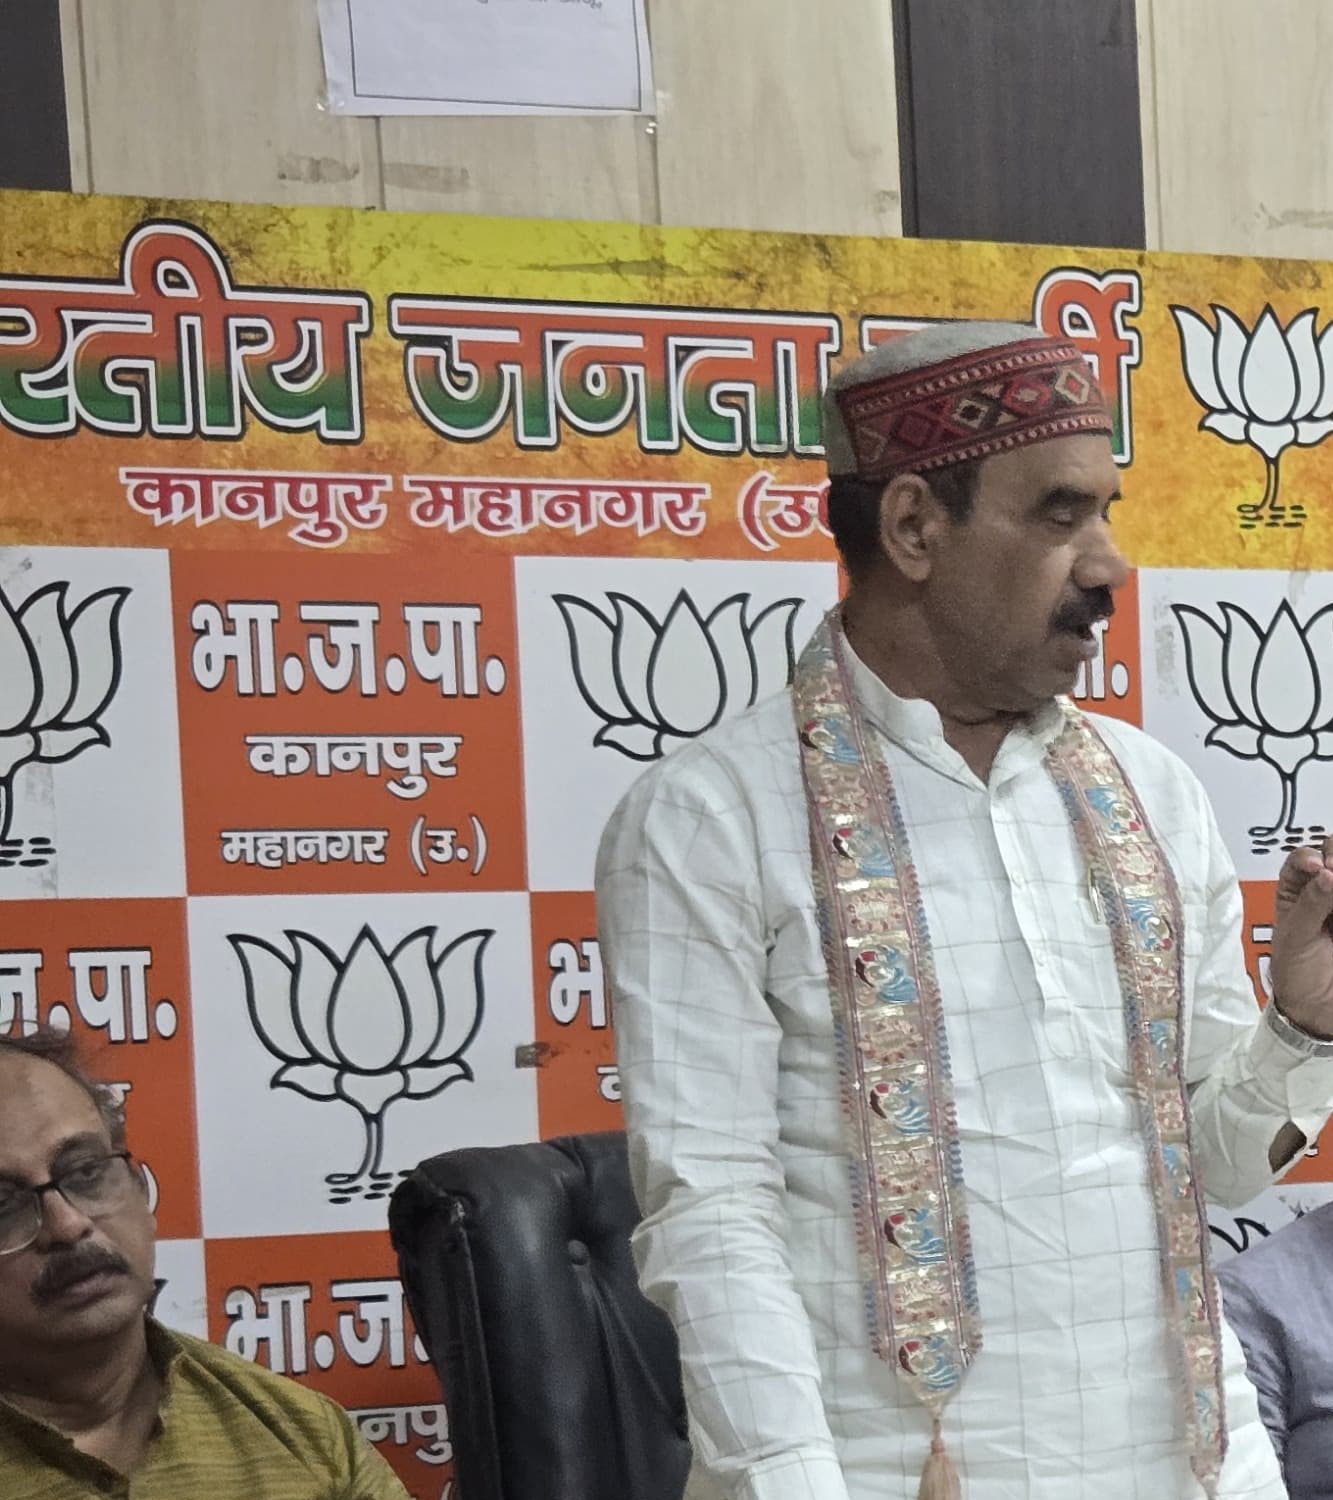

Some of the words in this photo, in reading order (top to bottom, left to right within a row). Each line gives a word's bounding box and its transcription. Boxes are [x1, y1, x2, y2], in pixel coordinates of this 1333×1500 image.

[388, 294, 840, 457] जनता
[119, 467, 393, 548] कानपुर
[403, 475, 711, 537] महानगर
[190, 600, 506, 698] भा.ज.पा.
[245, 734, 464, 799] कानपुर
[221, 828, 388, 869] महानगर
